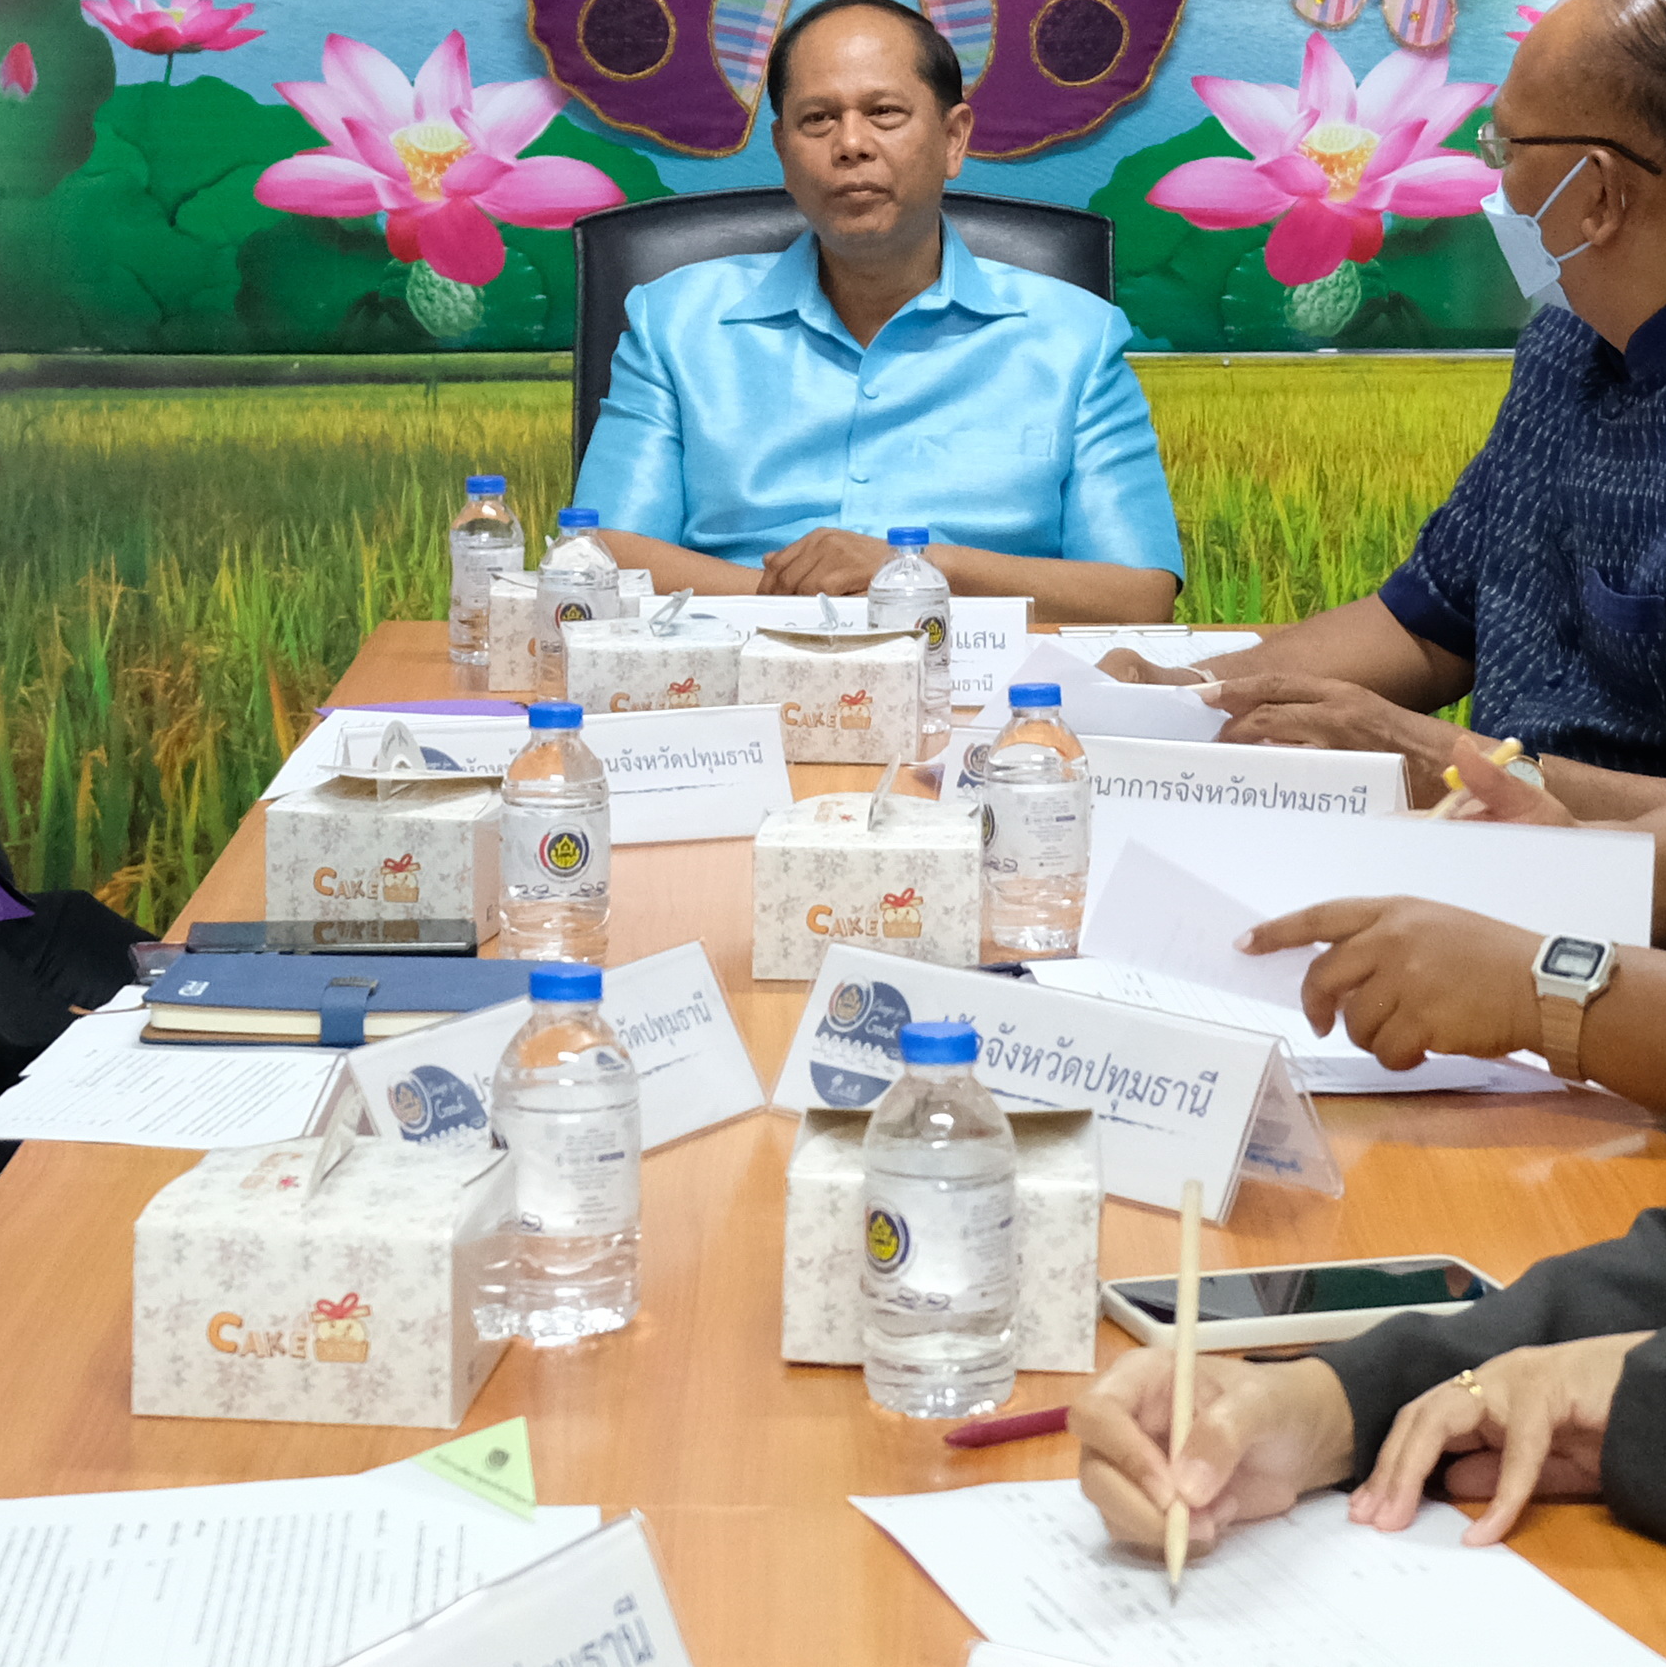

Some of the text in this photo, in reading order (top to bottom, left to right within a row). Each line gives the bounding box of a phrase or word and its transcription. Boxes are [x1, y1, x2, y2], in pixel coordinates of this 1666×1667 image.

[950, 628, 1006, 650] แสน
[1095, 771, 1367, 816] นาการจังหวัดปทมธานี
